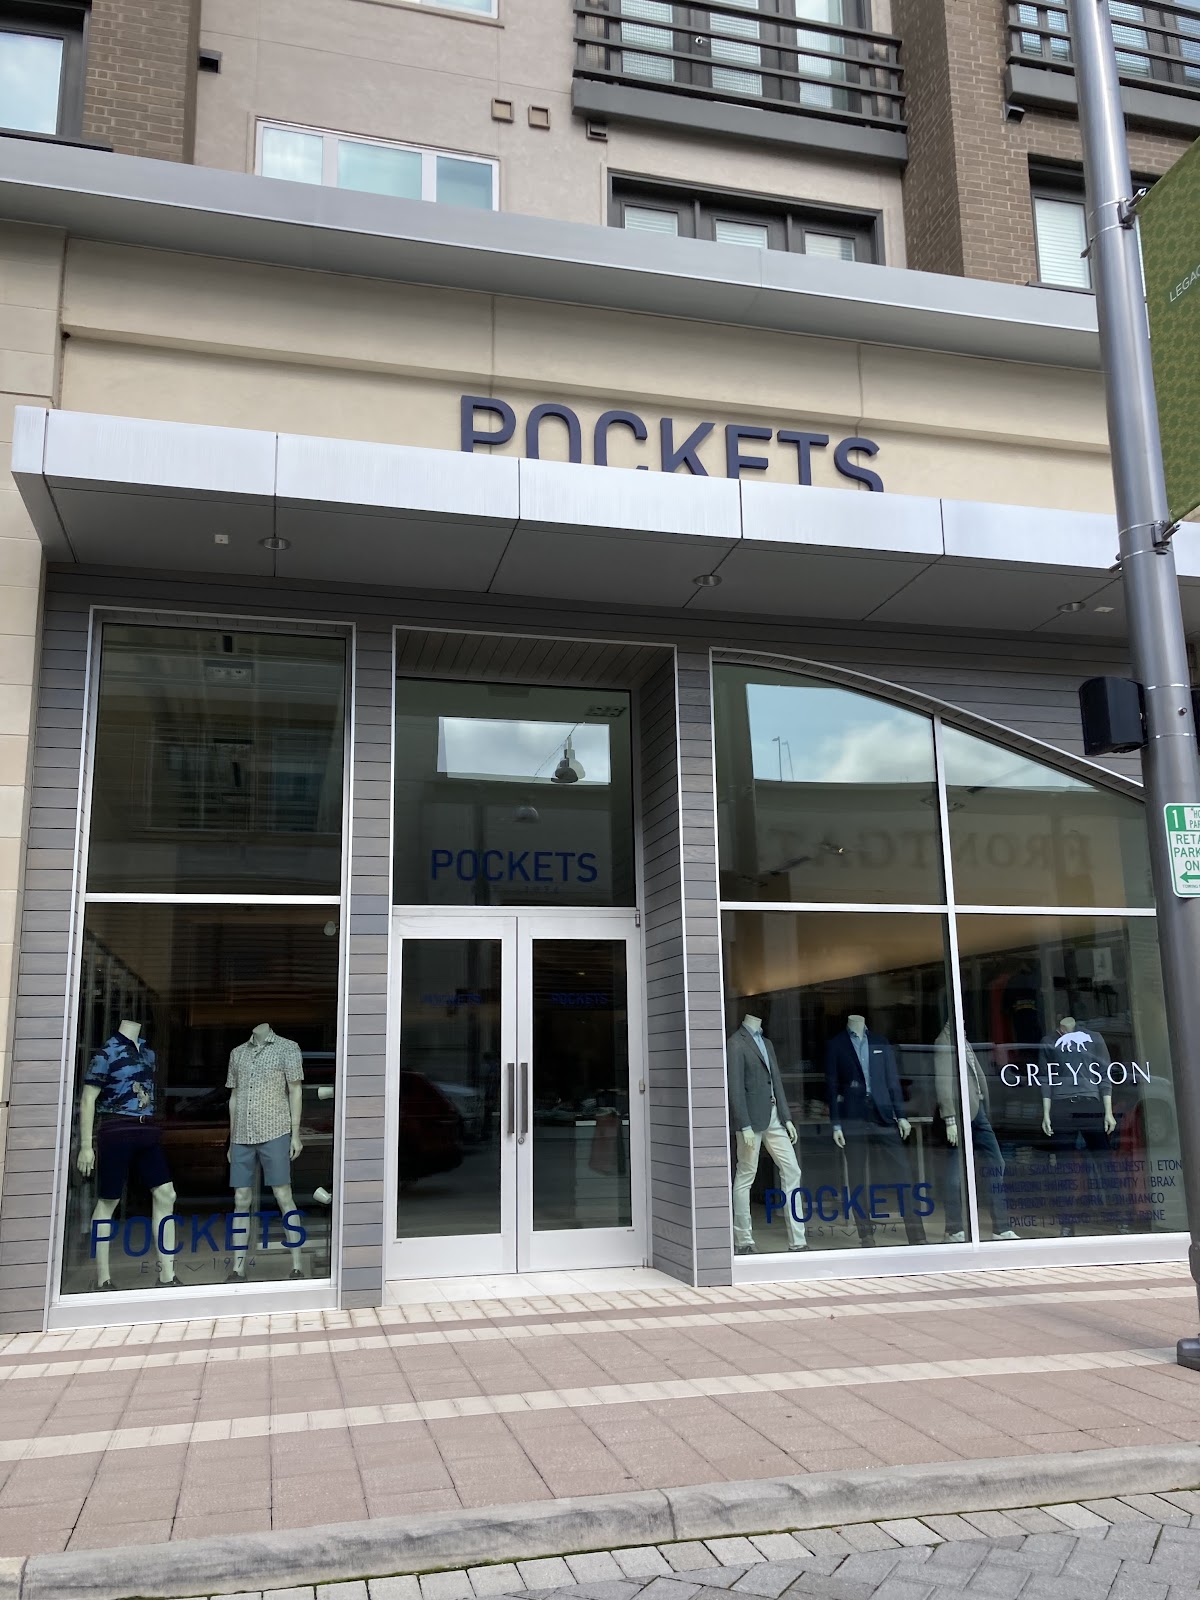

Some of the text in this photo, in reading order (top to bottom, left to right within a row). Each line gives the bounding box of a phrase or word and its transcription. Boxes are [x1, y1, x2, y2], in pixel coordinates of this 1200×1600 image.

[459, 393, 885, 493] POCKETS
[1172, 809, 1179, 829] 1
[430, 849, 599, 883] POCKETS
[1000, 1061, 1152, 1087] GREYSON
[1157, 1159, 1183, 1171] ETON
[1150, 1175, 1177, 1188] BRAX
[764, 1182, 936, 1224] POCKETS
[1009, 1214, 1038, 1228] PAIGE
[89, 1209, 308, 1259] POCKETS
[807, 1225, 836, 1239] EST
[140, 1256, 257, 1274] EST 1974
